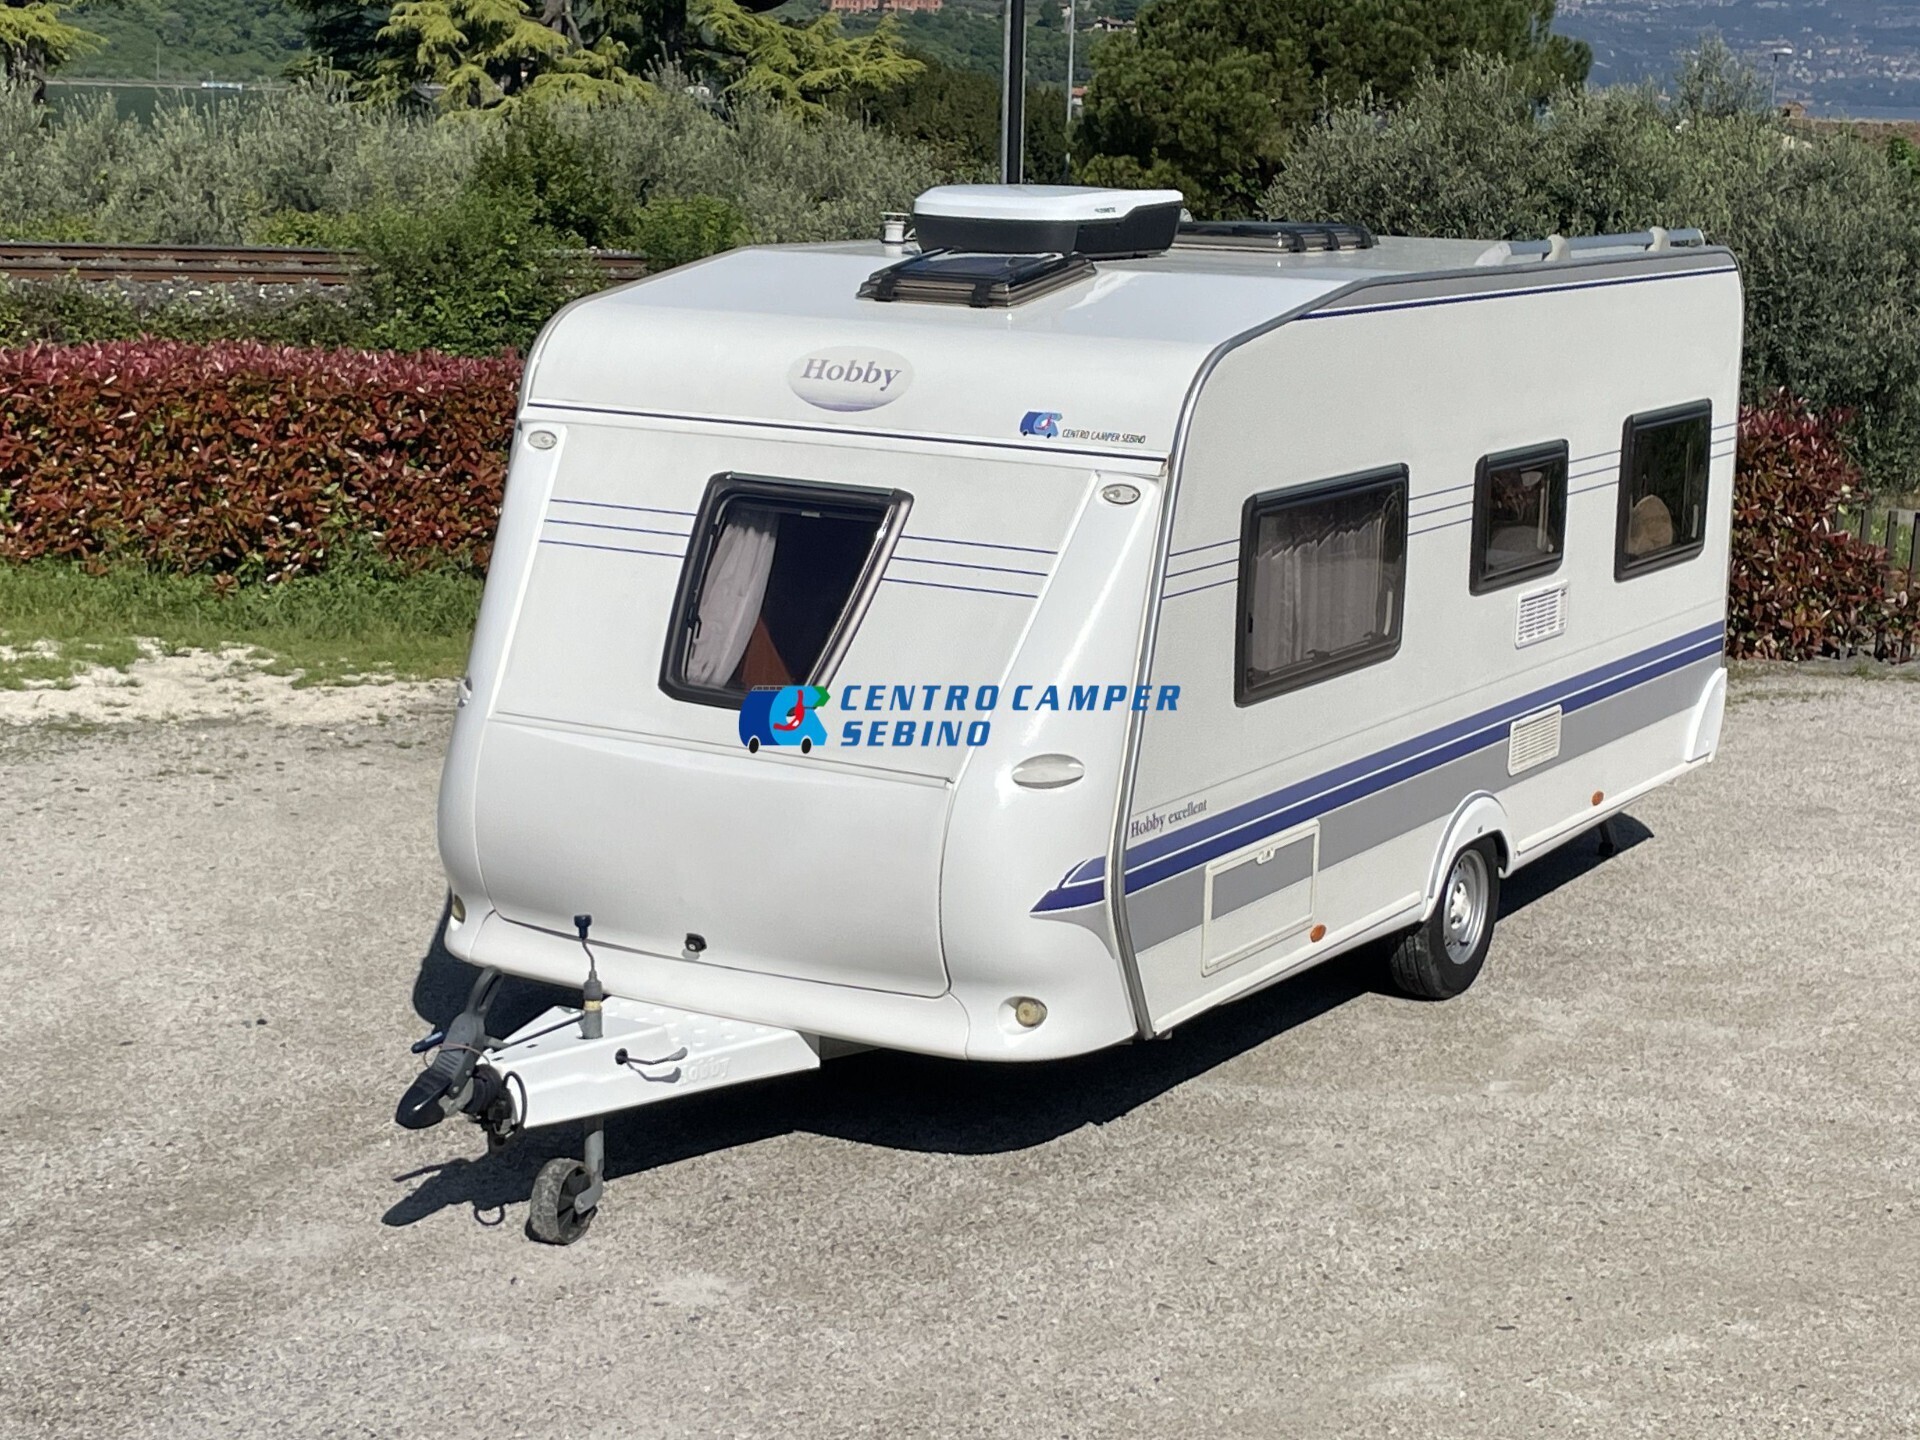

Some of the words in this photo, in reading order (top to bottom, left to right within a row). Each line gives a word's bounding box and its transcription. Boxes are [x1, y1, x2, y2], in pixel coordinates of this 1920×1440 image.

[801, 358, 902, 391] Hobby
[1062, 428, 1090, 439] CENTRO
[1091, 431, 1121, 442] CAMPER
[1122, 433, 1146, 444] SEBINO
[1130, 812, 1166, 838] Hobby
[1168, 799, 1207, 824] excellent
